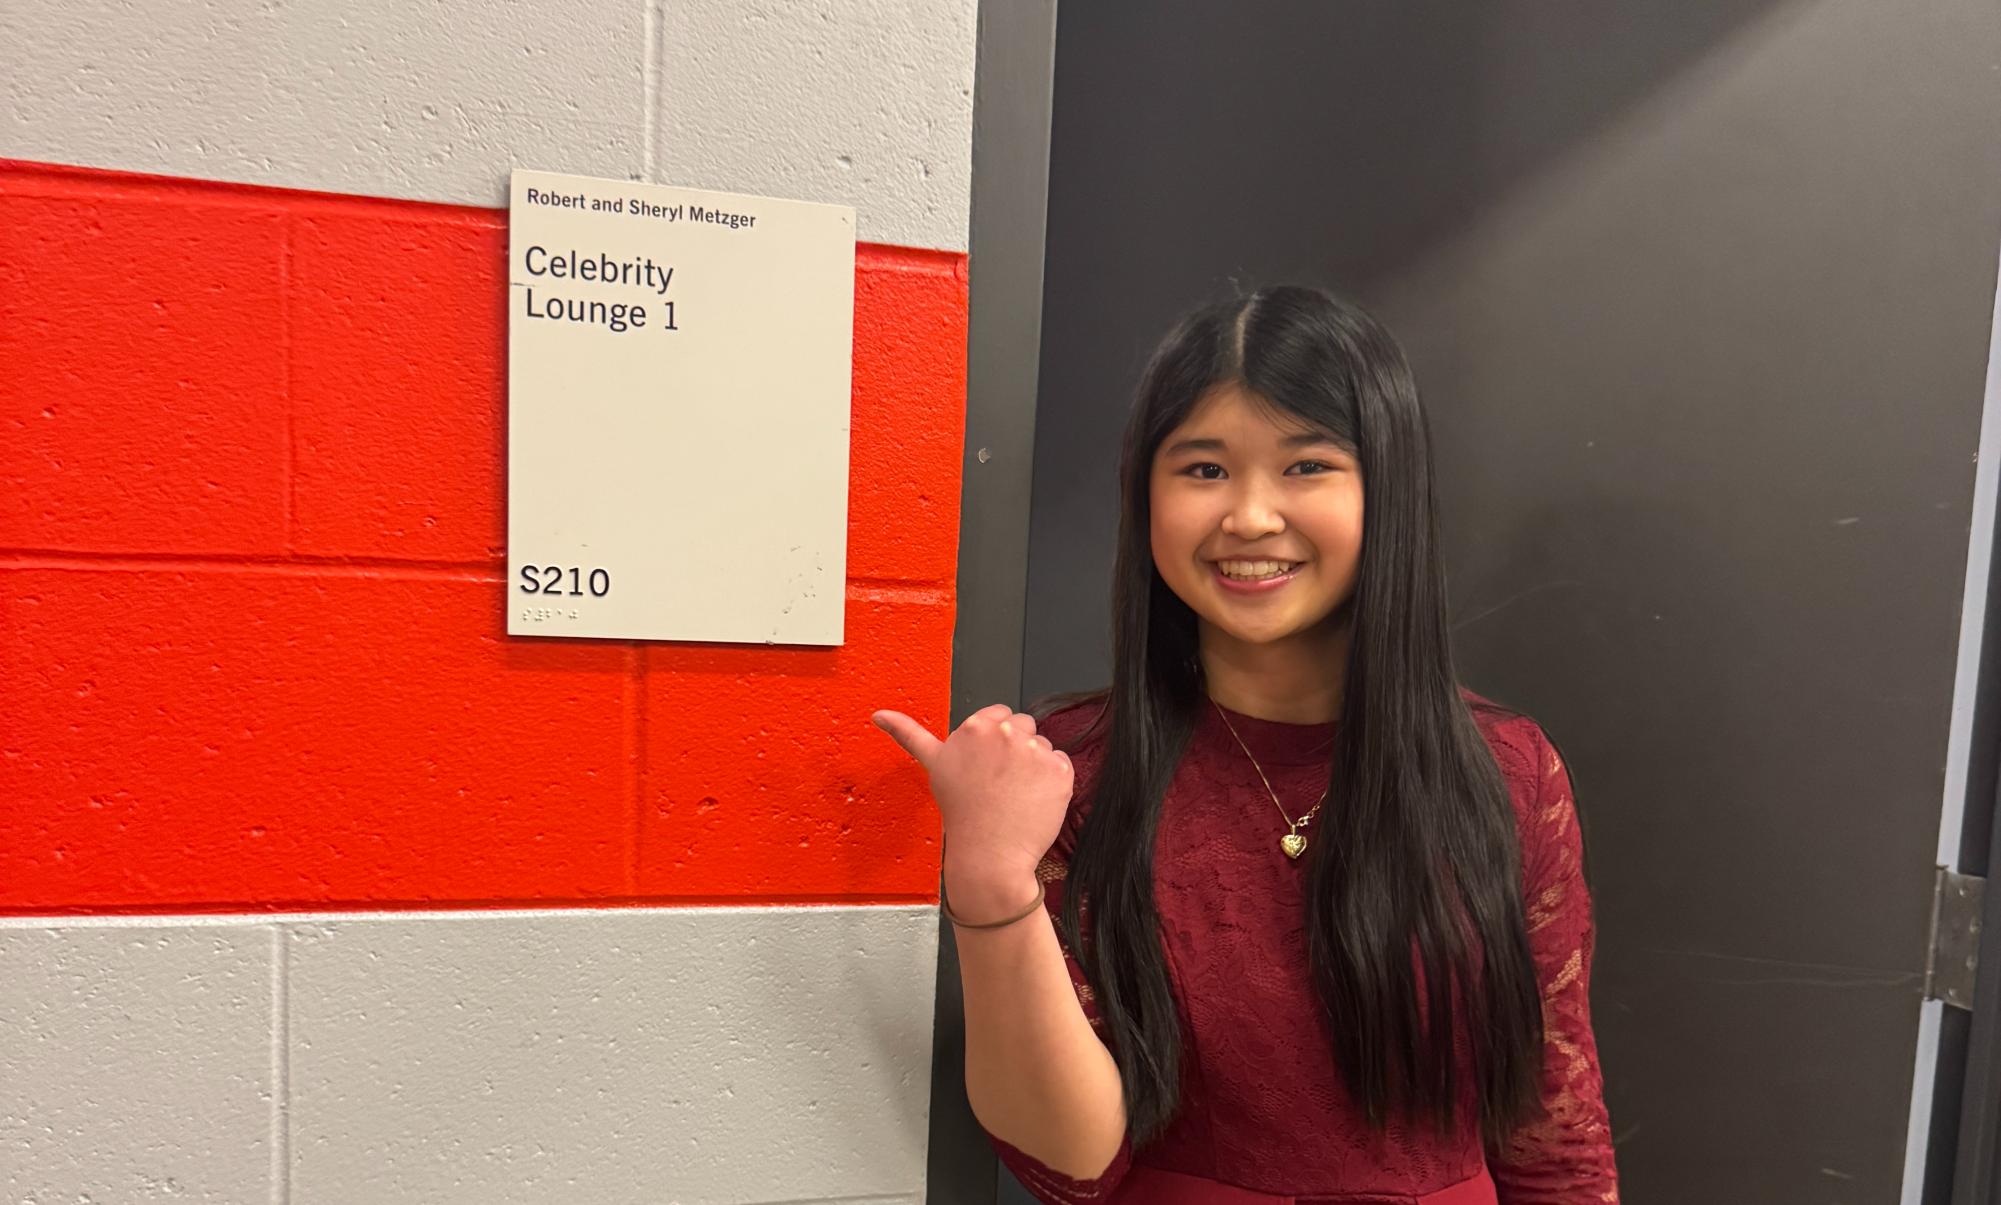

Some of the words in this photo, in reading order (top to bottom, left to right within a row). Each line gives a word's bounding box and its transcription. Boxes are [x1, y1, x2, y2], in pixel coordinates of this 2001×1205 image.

[527, 188, 586, 209] Robert
[592, 198, 623, 213] and
[629, 199, 683, 223] Sheryl
[690, 206, 756, 229] Metzger
[525, 246, 674, 295] Celebrity
[526, 288, 647, 333] Lounge
[665, 301, 679, 331] 1
[519, 564, 610, 597] S210
